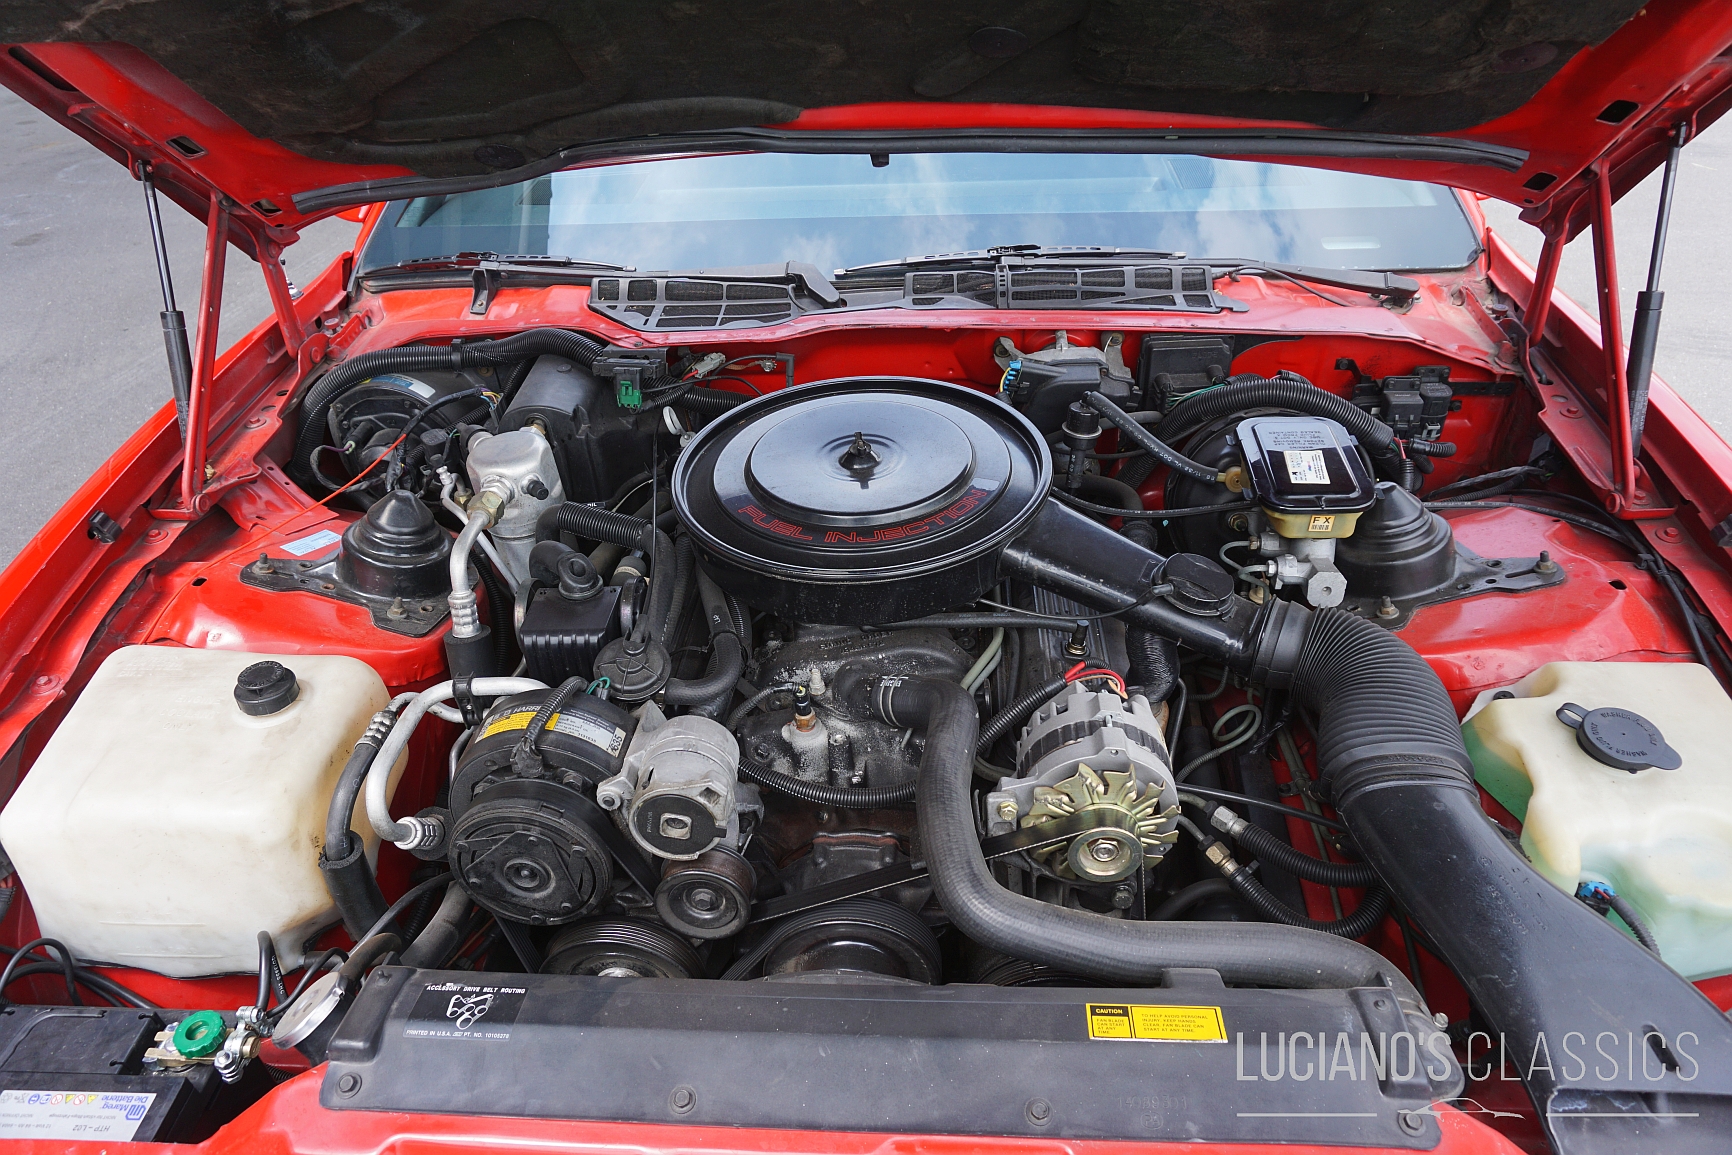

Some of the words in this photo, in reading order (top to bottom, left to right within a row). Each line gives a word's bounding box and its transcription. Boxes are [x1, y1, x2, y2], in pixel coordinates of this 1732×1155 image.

[738, 504, 813, 541] FUEL
[824, 488, 988, 544] INJECTION
[101, 1095, 133, 1103] Batterie
[102, 1102, 126, 1111] Mareg
